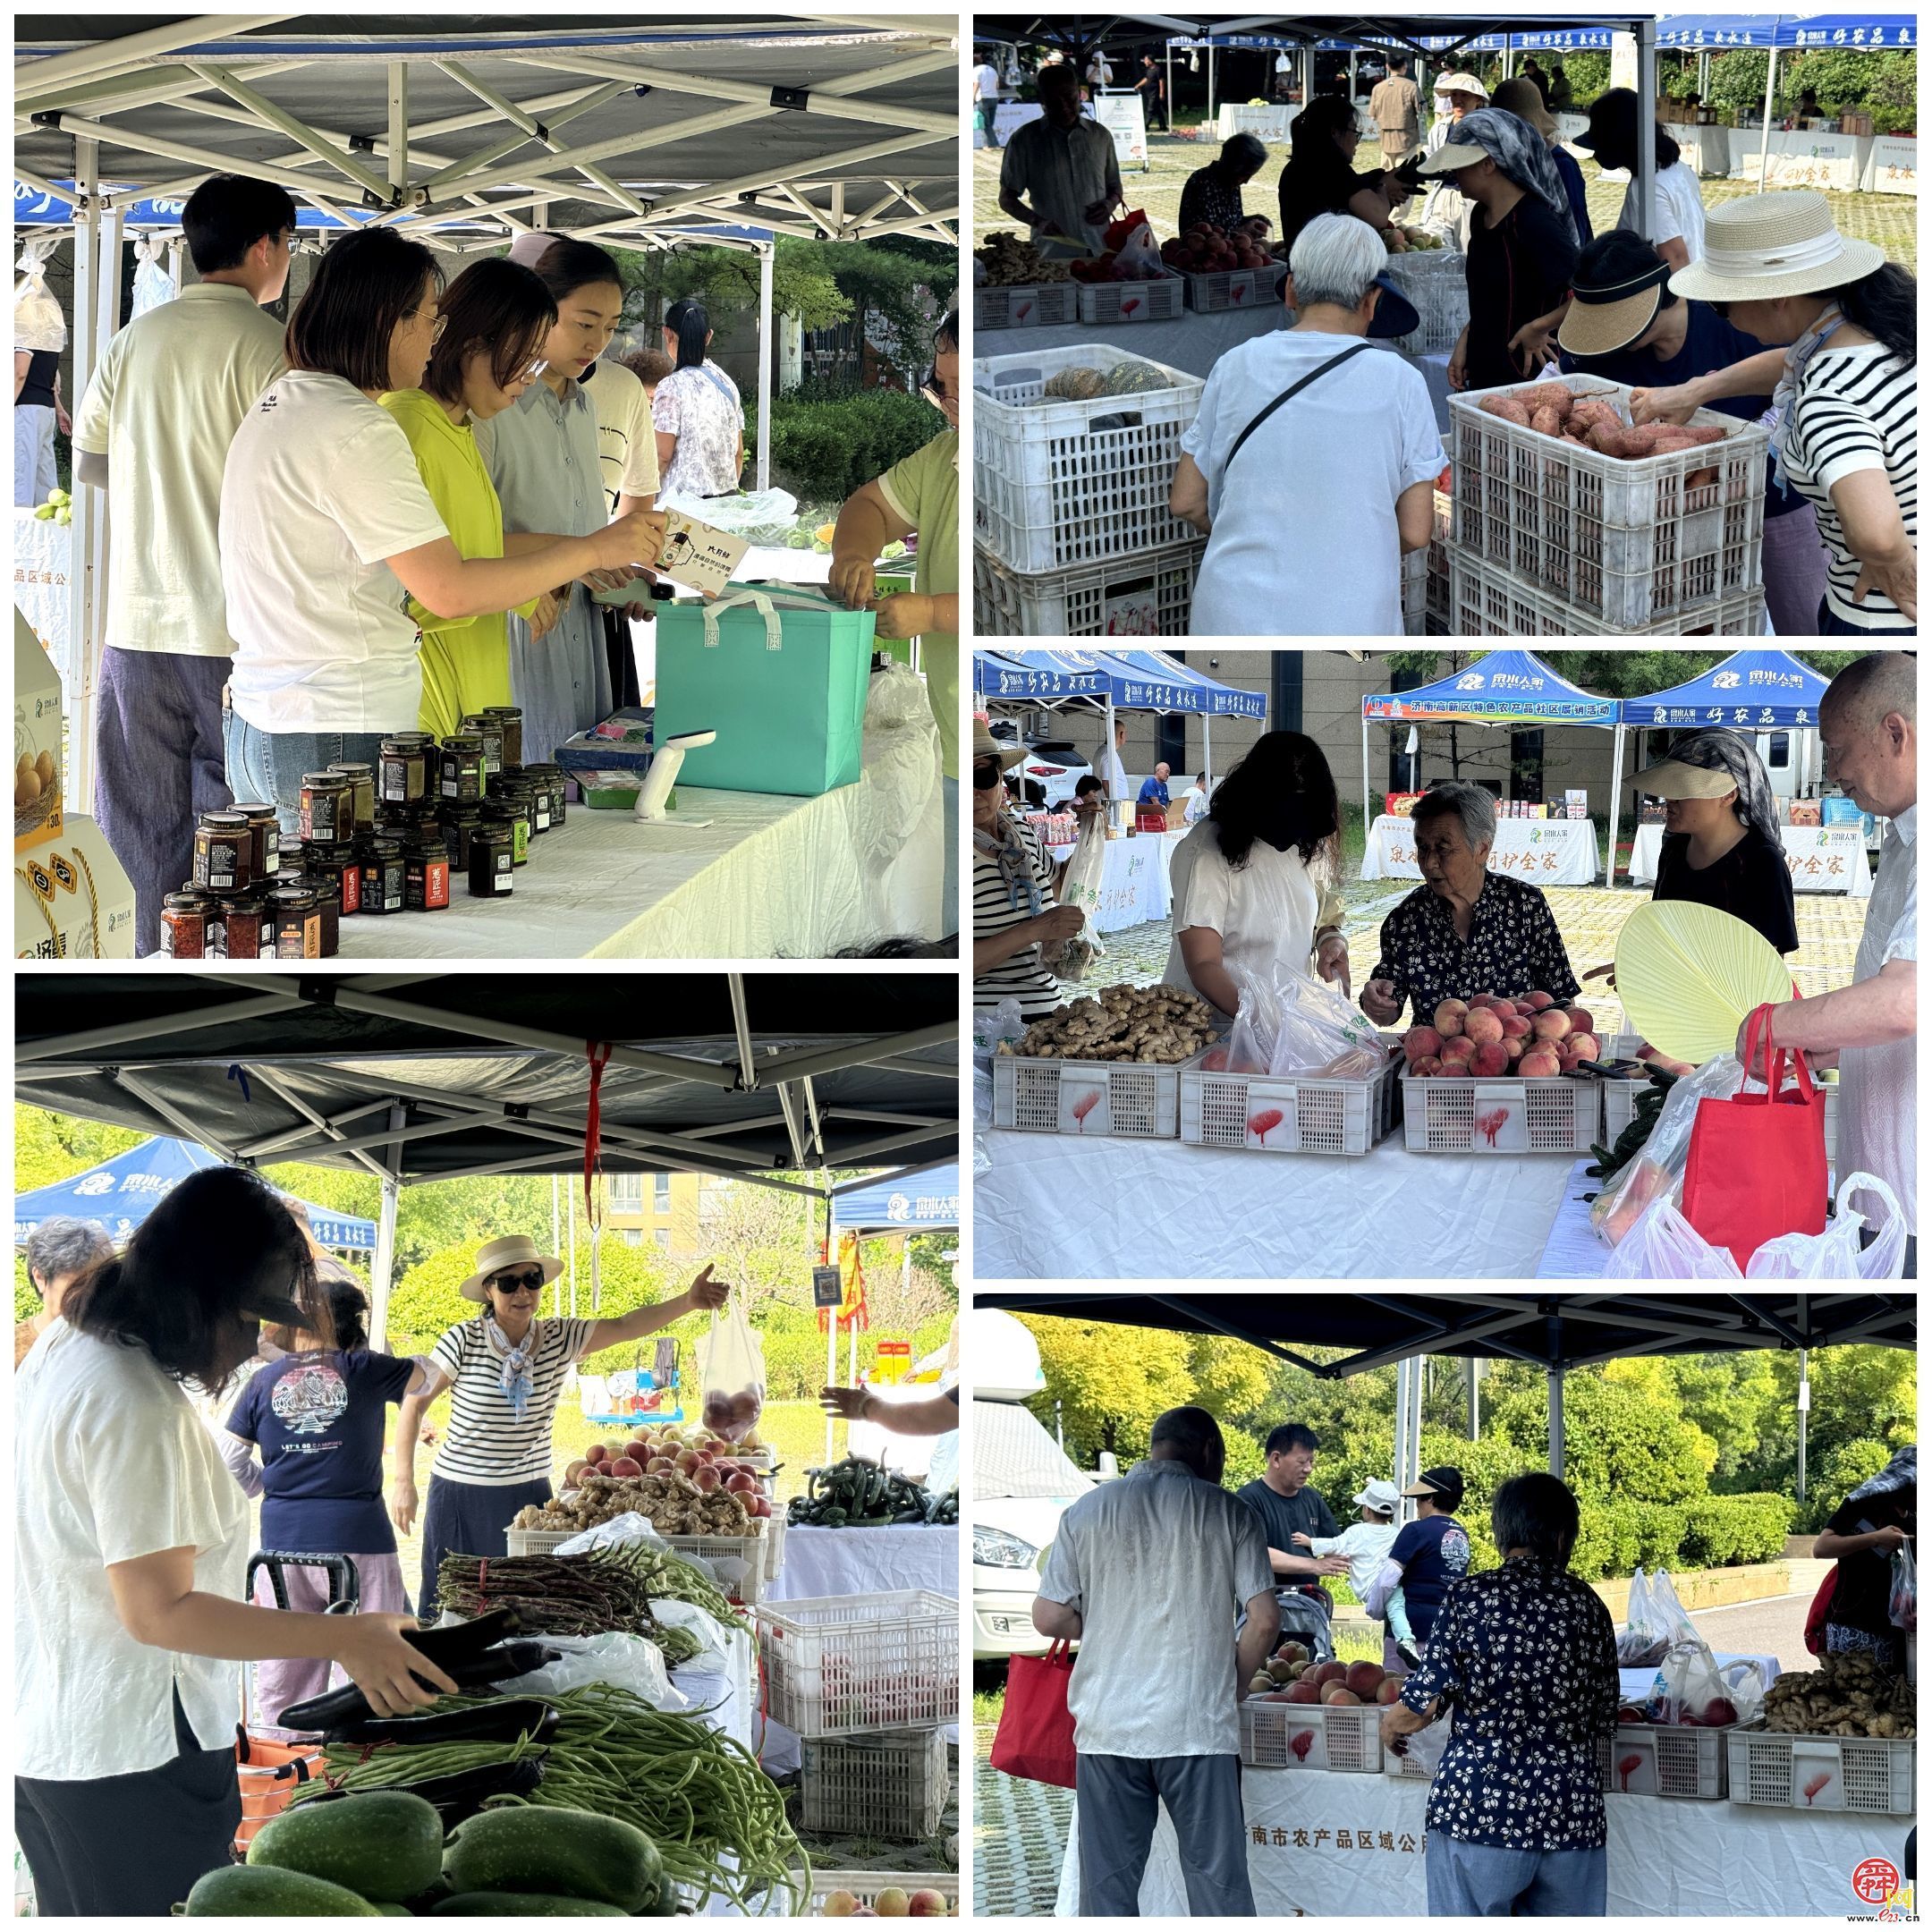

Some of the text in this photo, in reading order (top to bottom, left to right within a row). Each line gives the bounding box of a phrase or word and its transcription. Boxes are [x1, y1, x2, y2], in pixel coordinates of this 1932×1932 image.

[1833, 27, 1884, 44] 好农品
[1492, 674, 1545, 686] 泉水人家
[1748, 670, 1803, 683] 泉水人家
[1411, 700, 1610, 716] 济南高新区特色农产品社区展销活动
[1670, 708, 1697, 718] 泉水人家
[1706, 707, 1810, 724] 好农品 泉
[1543, 828, 1568, 838] 泉水人家
[1245, 1825, 1428, 1854] 南市农产品区域公
